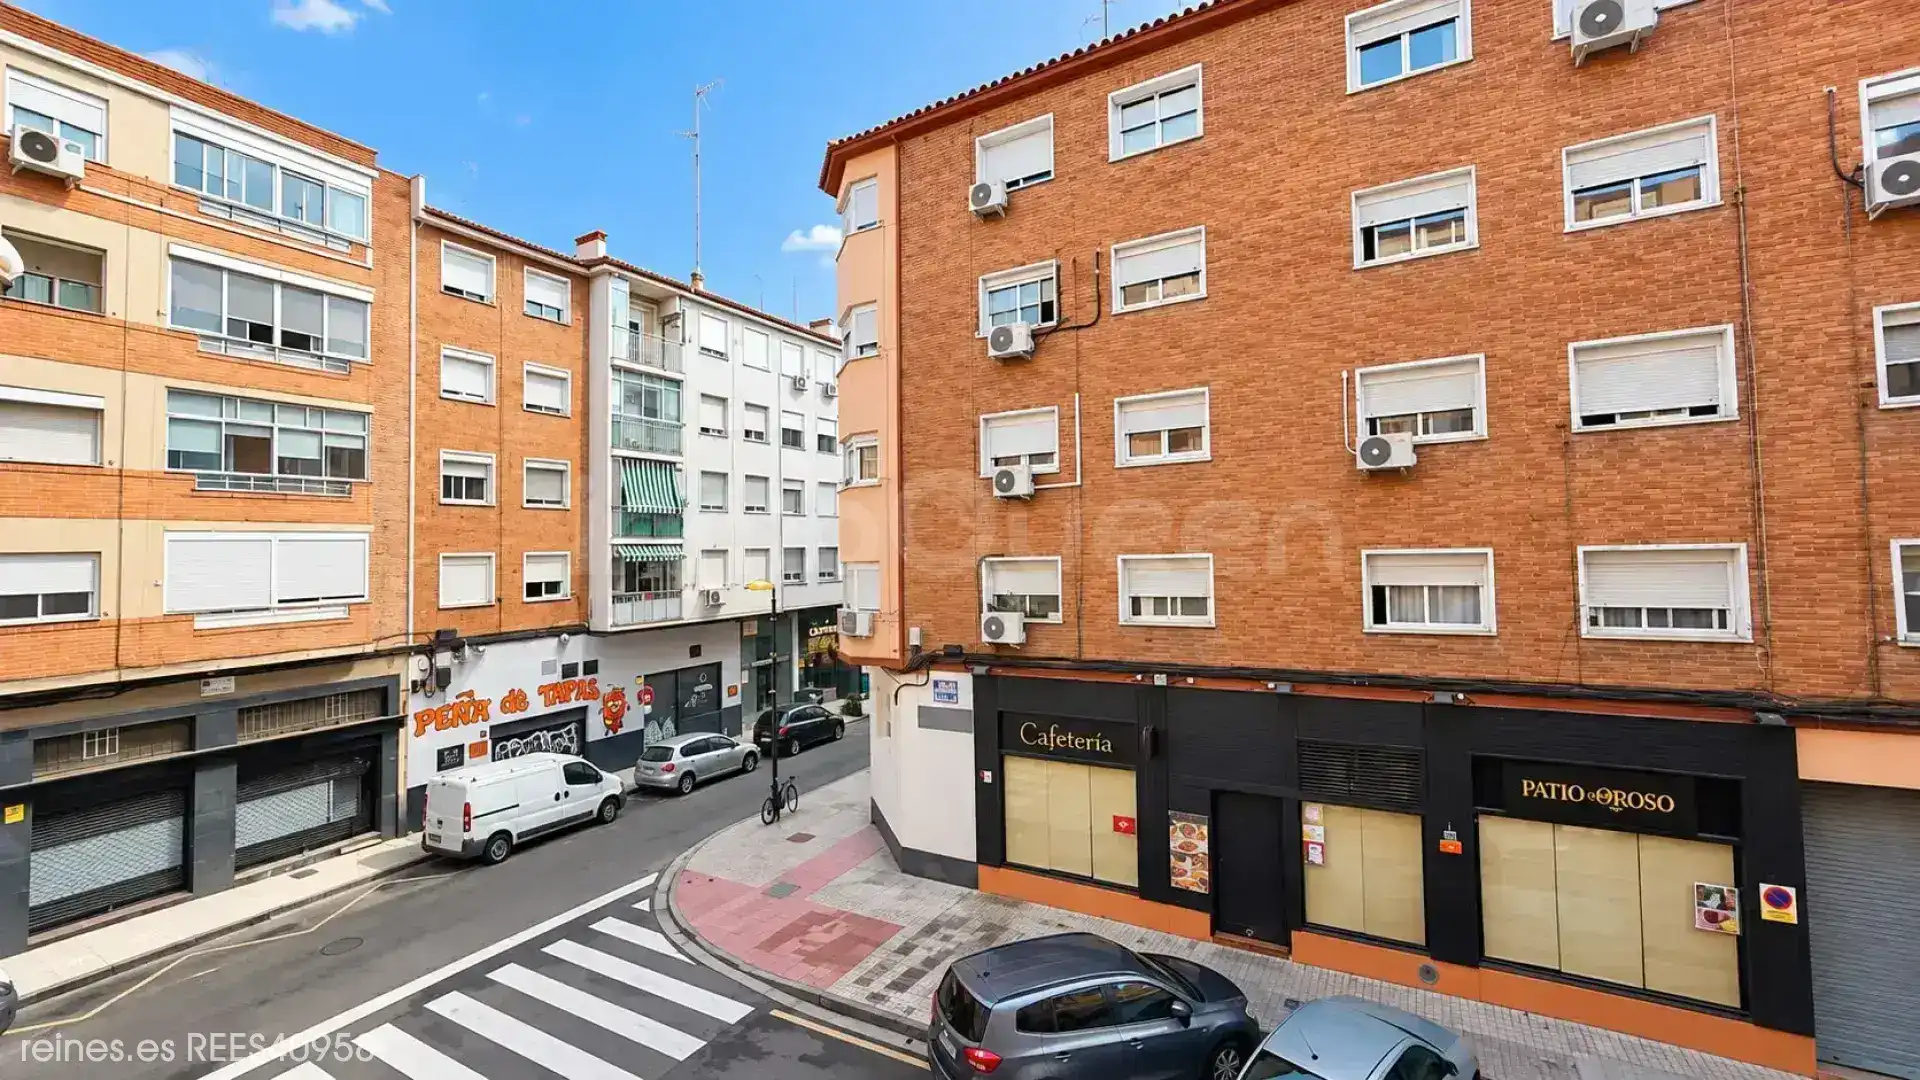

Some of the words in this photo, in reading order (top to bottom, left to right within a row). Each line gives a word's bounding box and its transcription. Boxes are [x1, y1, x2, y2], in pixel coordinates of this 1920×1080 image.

[414, 689, 492, 737] PEÑA
[500, 688, 530, 714] de
[537, 678, 600, 707] TAPAS
[1020, 721, 1113, 753] Cafetería
[1522, 779, 1585, 802] PATIO
